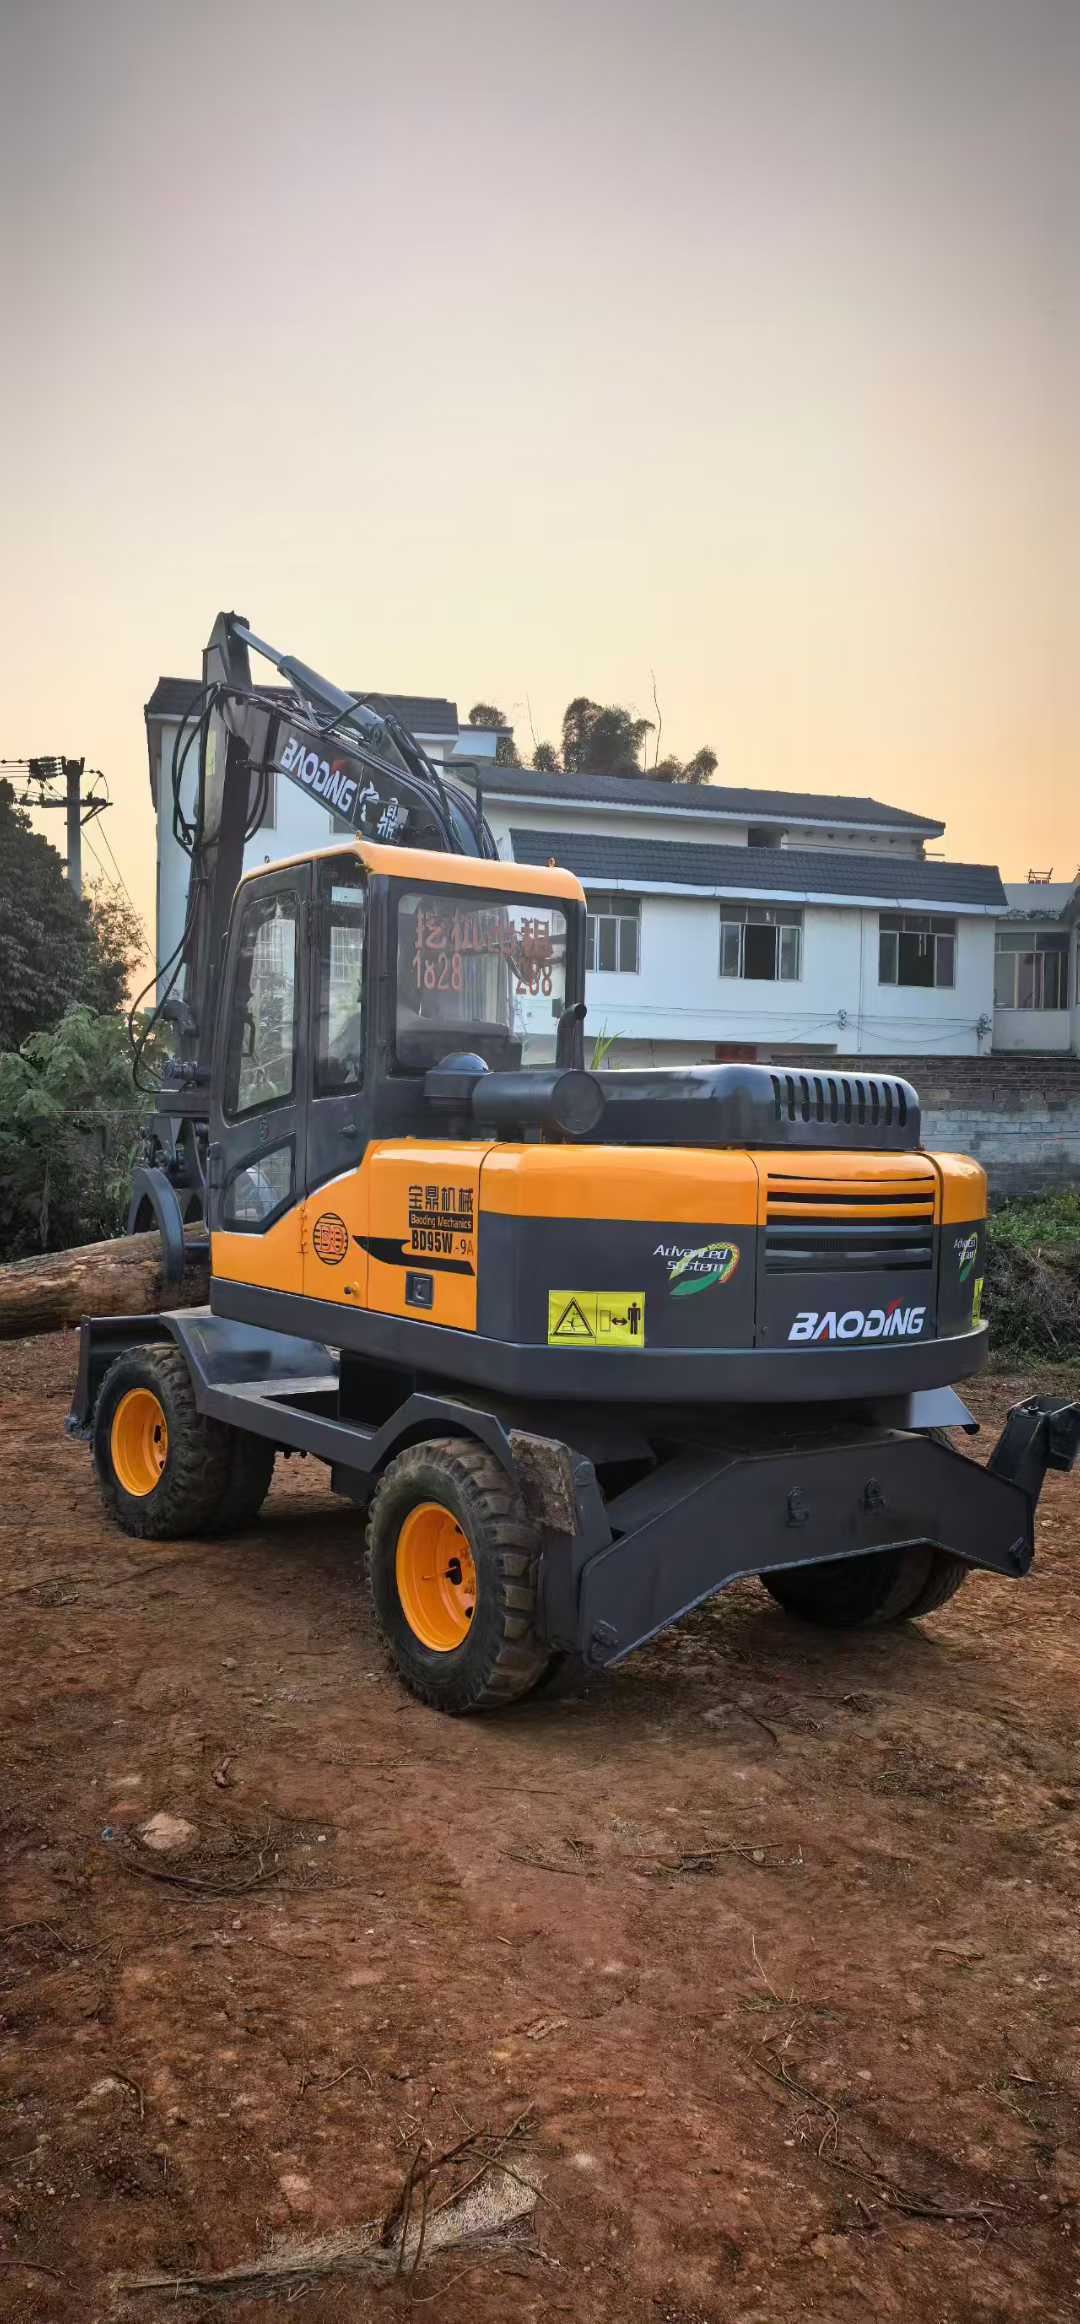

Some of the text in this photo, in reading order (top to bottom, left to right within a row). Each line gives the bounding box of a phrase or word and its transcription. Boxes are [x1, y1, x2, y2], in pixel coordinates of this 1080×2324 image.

[280, 737, 357, 812] BAODING
[408, 1185, 473, 1213] 宝鼎机械
[411, 1214, 472, 1229] Baoding Mechanics
[653, 1244, 729, 1260] Advanced
[788, 1300, 927, 1342] BAODING
